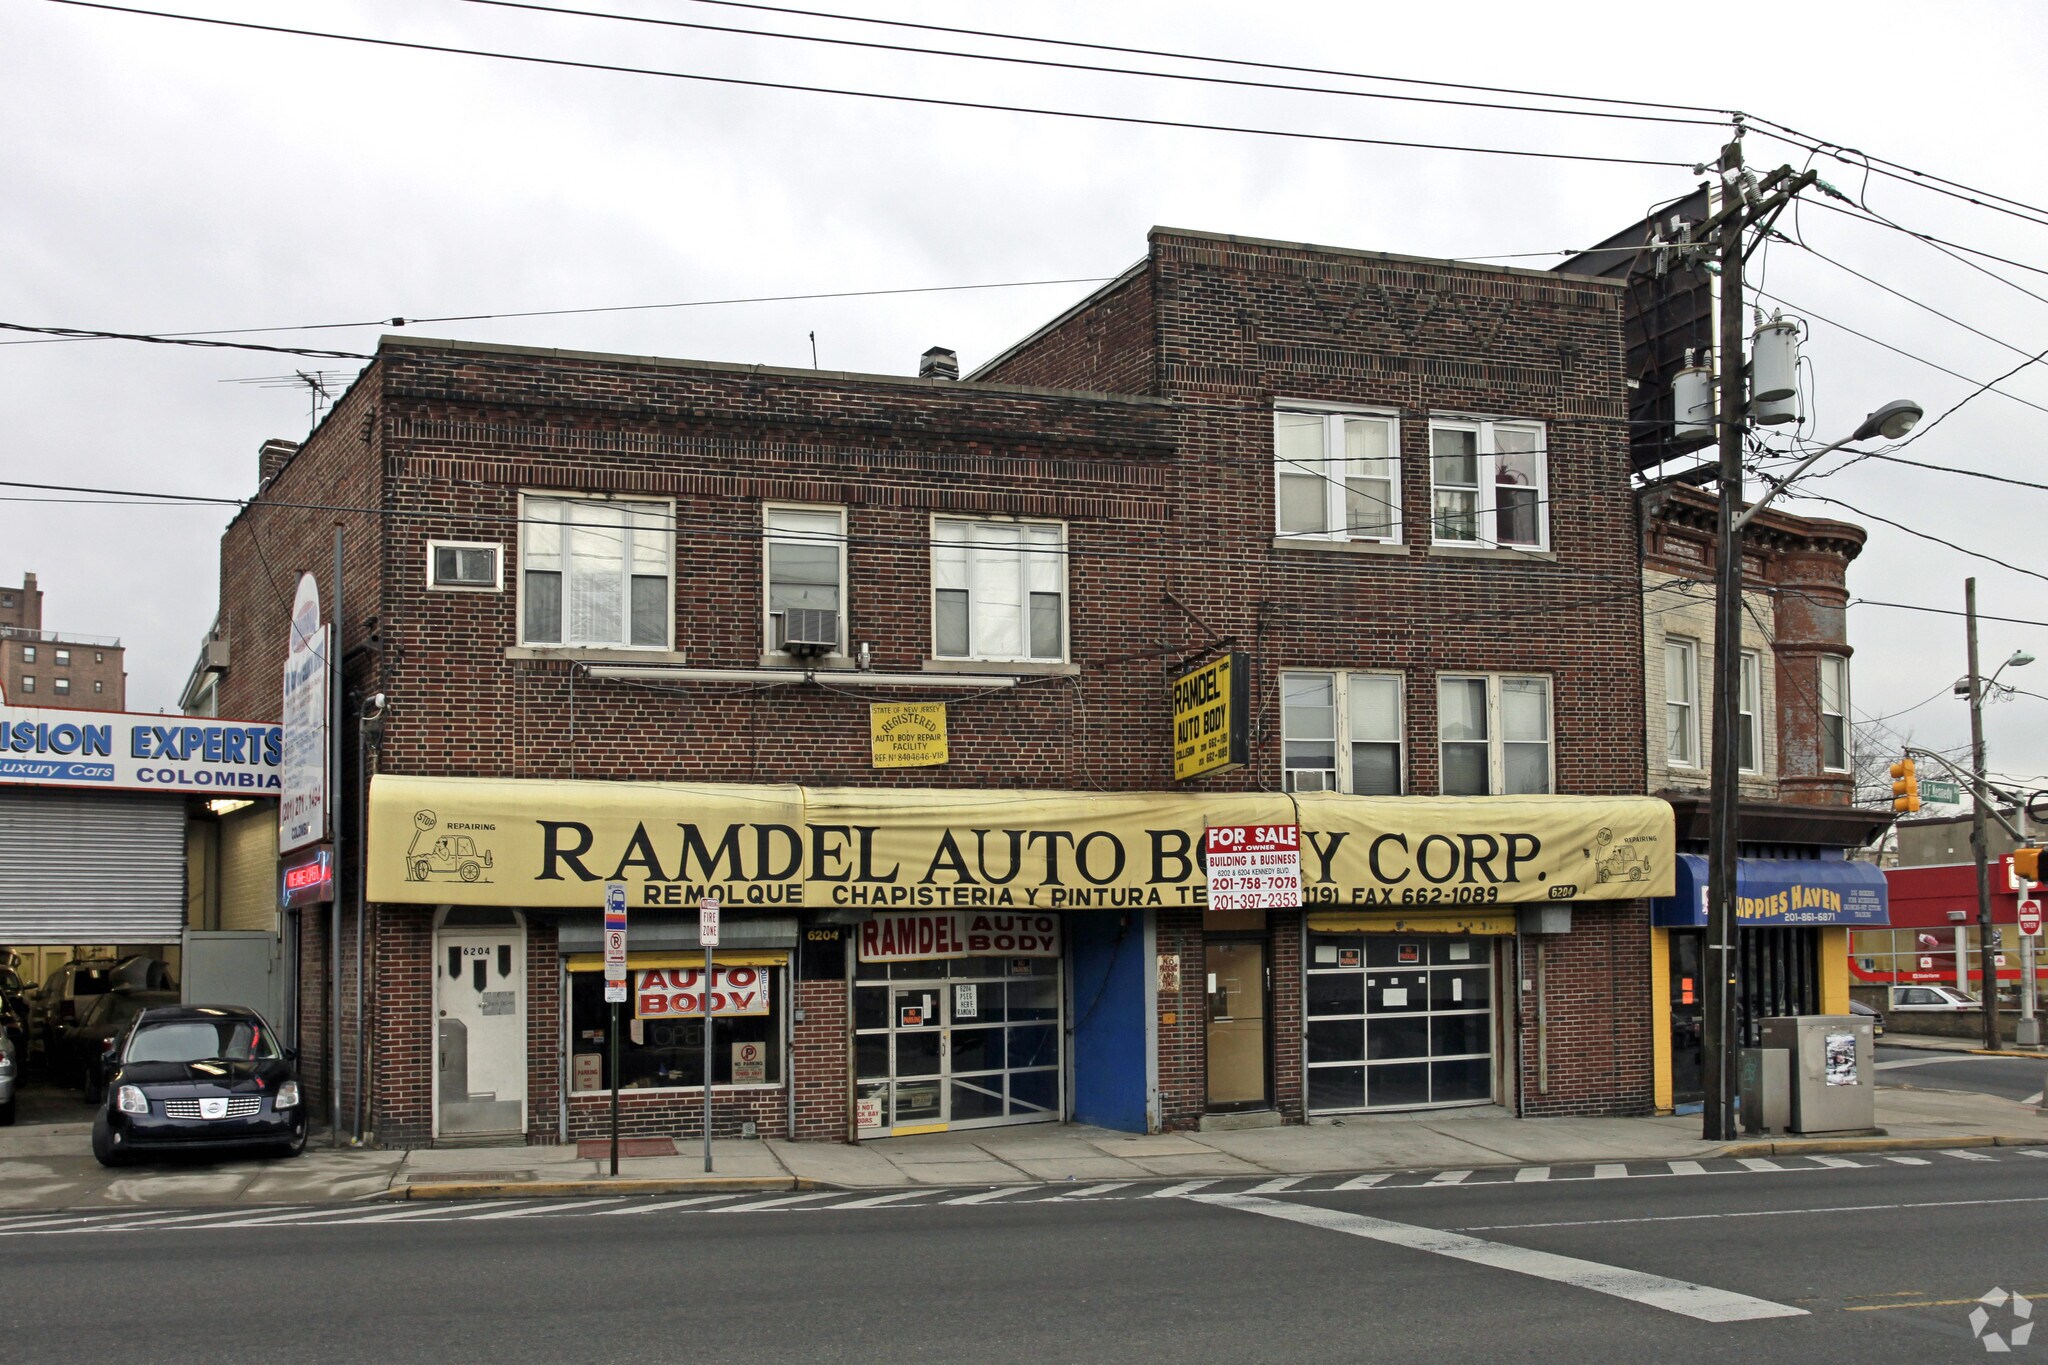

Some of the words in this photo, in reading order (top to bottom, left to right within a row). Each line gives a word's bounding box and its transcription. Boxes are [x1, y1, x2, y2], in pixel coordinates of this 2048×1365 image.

[1174, 667, 1220, 716] RAMDEL
[881, 713, 936, 734] REGISTERED
[1178, 715, 1200, 745] AUTO
[1204, 703, 1226, 735] BODY
[875, 734, 894, 742] AUTO
[898, 734, 916, 742] BODY
[131, 726, 283, 766] EXPERTS
[1176, 746, 1194, 760] COLLISION
[0, 763, 60, 776] uxury
[68, 764, 112, 777] Cars
[136, 768, 282, 788] COLOMBIA
[417, 813, 434, 827] STOP
[448, 822, 496, 830] REPAIRING
[1209, 828, 1246, 848] FOR
[1255, 826, 1296, 846] SALE
[1598, 832, 1611, 840] STOP
[534, 820, 900, 884] RAMDEL
[917, 828, 1126, 886] AUTO
[1145, 830, 1350, 885] BY
[1369, 832, 1547, 884] CORP.
[1210, 856, 1246, 867] BUILDING
[1251, 856, 1256, 866] &
[1260, 854, 1296, 865] BUSINESS
[1212, 876, 1297, 890] 201-758-7078
[644, 884, 802, 904] REMOLQUE
[832, 885, 1014, 906] CHAPISTERIA
[1025, 888, 1039, 906] Y
[1052, 888, 1162, 906] PINTURA
[1176, 886, 1208, 905] TE
[1352, 888, 1394, 904] FAX
[1402, 886, 1498, 904] 662-1089
[1552, 887, 1574, 898] 6204
[1214, 892, 1298, 910] 201-397-2353
[1736, 891, 1788, 918] UPPIES
[1790, 885, 1842, 912] HAVEN
[704, 912, 716, 922] FIRE
[971, 915, 1053, 932] AUTO
[1784, 913, 1836, 922] 201-861-6871
[703, 926, 716, 936] ZONE
[808, 930, 838, 940] 6204
[863, 916, 963, 956] RAMDEL
[968, 935, 1054, 951] BODY
[464, 947, 490, 956] 6204
[1163, 958, 1174, 966] NO
[639, 967, 757, 991] AUTO
[640, 992, 756, 1014] BODY
[904, 1016, 921, 1024] PARKING
